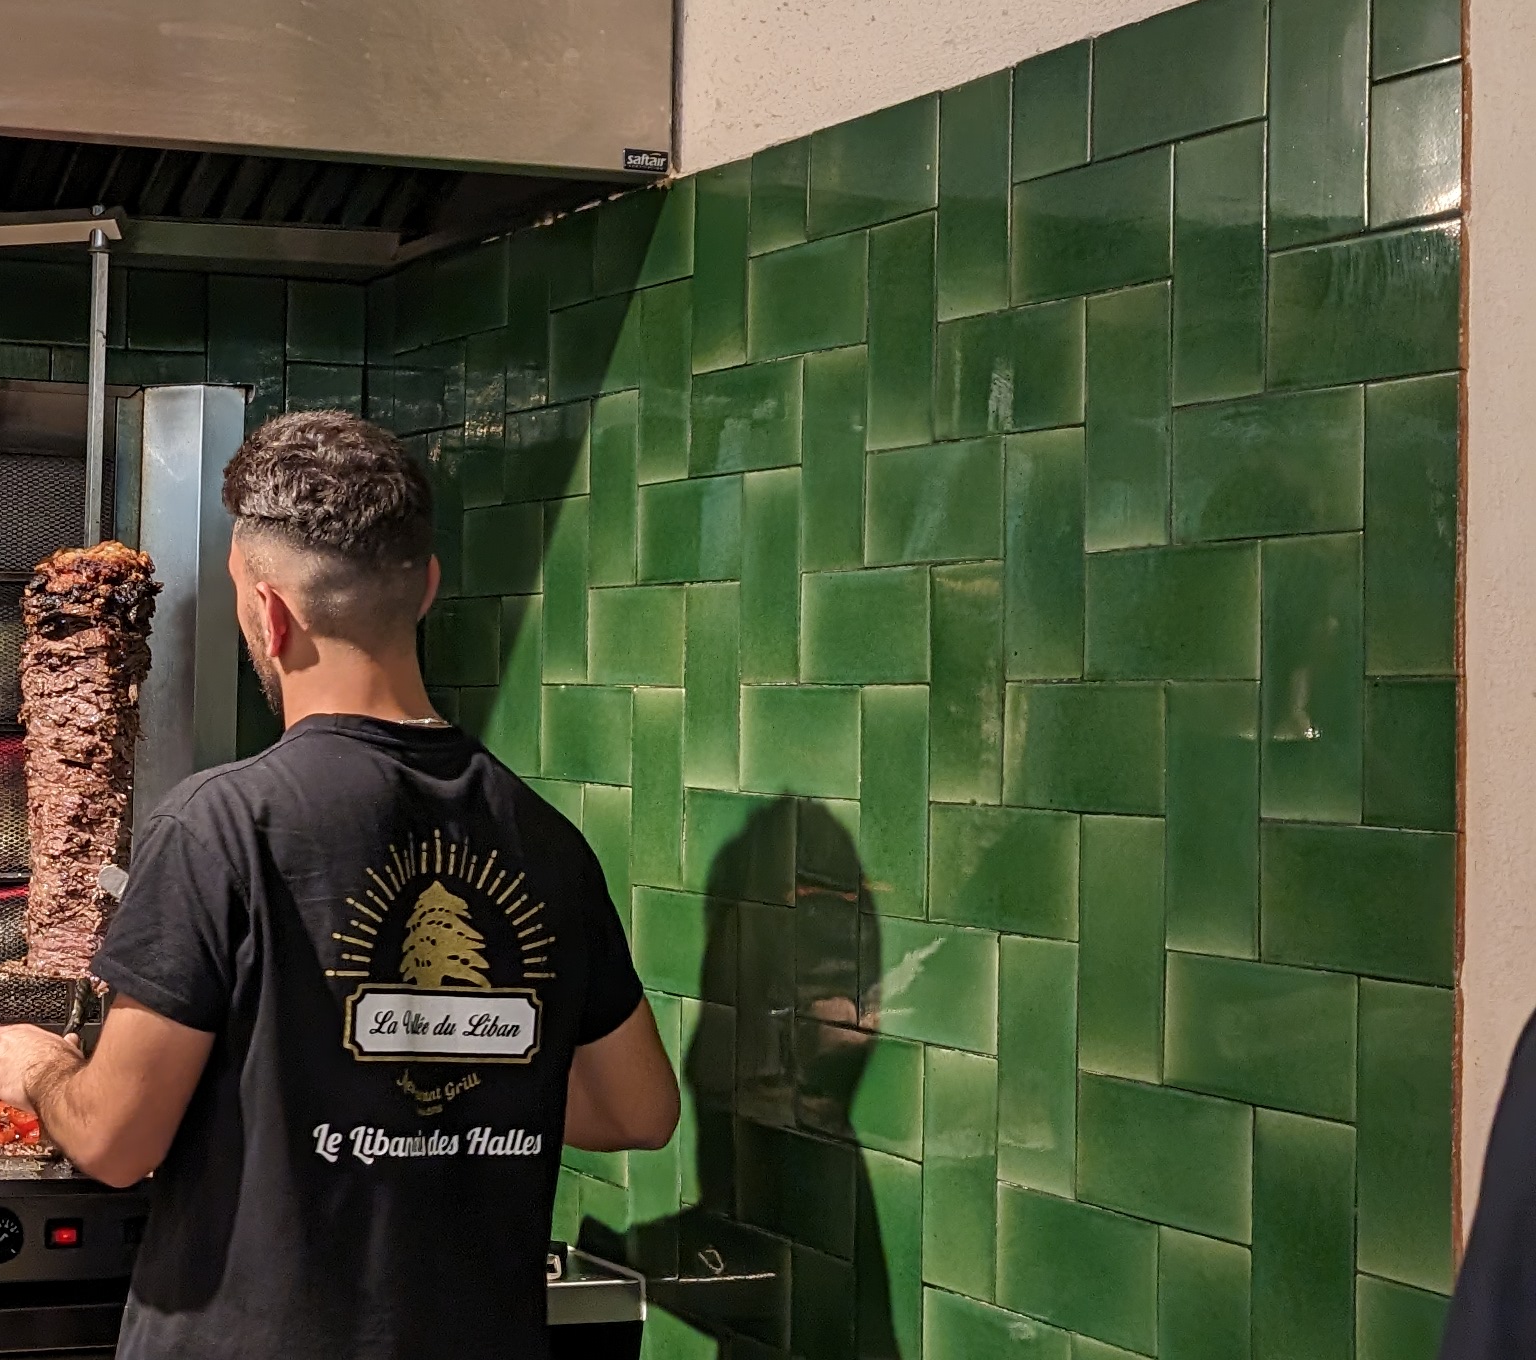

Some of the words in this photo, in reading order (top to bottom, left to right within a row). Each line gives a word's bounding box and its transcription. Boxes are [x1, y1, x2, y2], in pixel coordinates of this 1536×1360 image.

[626, 152, 667, 167] saftair
[369, 1009, 398, 1035] La
[433, 1014, 457, 1036] du
[462, 1013, 521, 1038] Liban
[445, 1072, 482, 1101] Grill
[312, 1123, 343, 1163] Le
[427, 1129, 460, 1158] des
[466, 1126, 542, 1156] Halles
